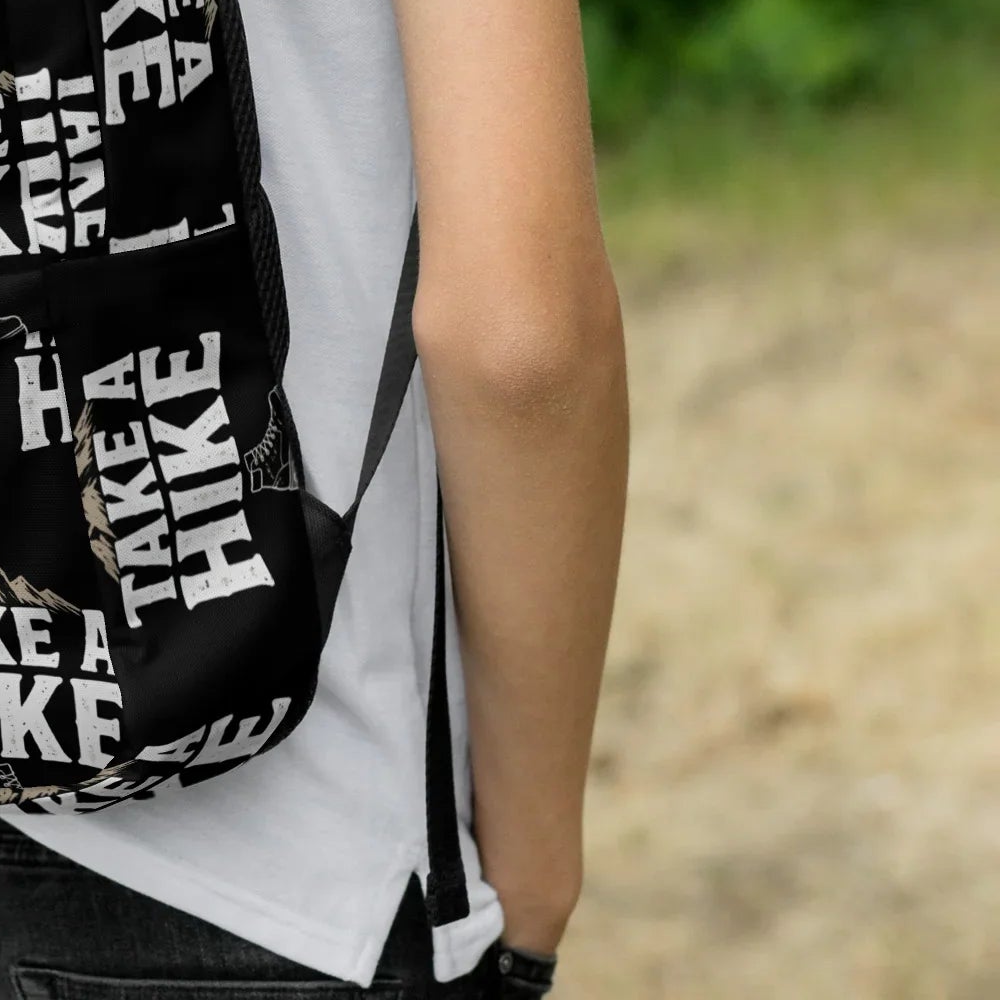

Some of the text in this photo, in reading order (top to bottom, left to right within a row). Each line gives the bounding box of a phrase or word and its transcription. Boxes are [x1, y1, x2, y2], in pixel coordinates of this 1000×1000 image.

[173, 39, 213, 103] A
[82, 352, 177, 628] TAKE A
[139, 331, 275, 611] HIKE
